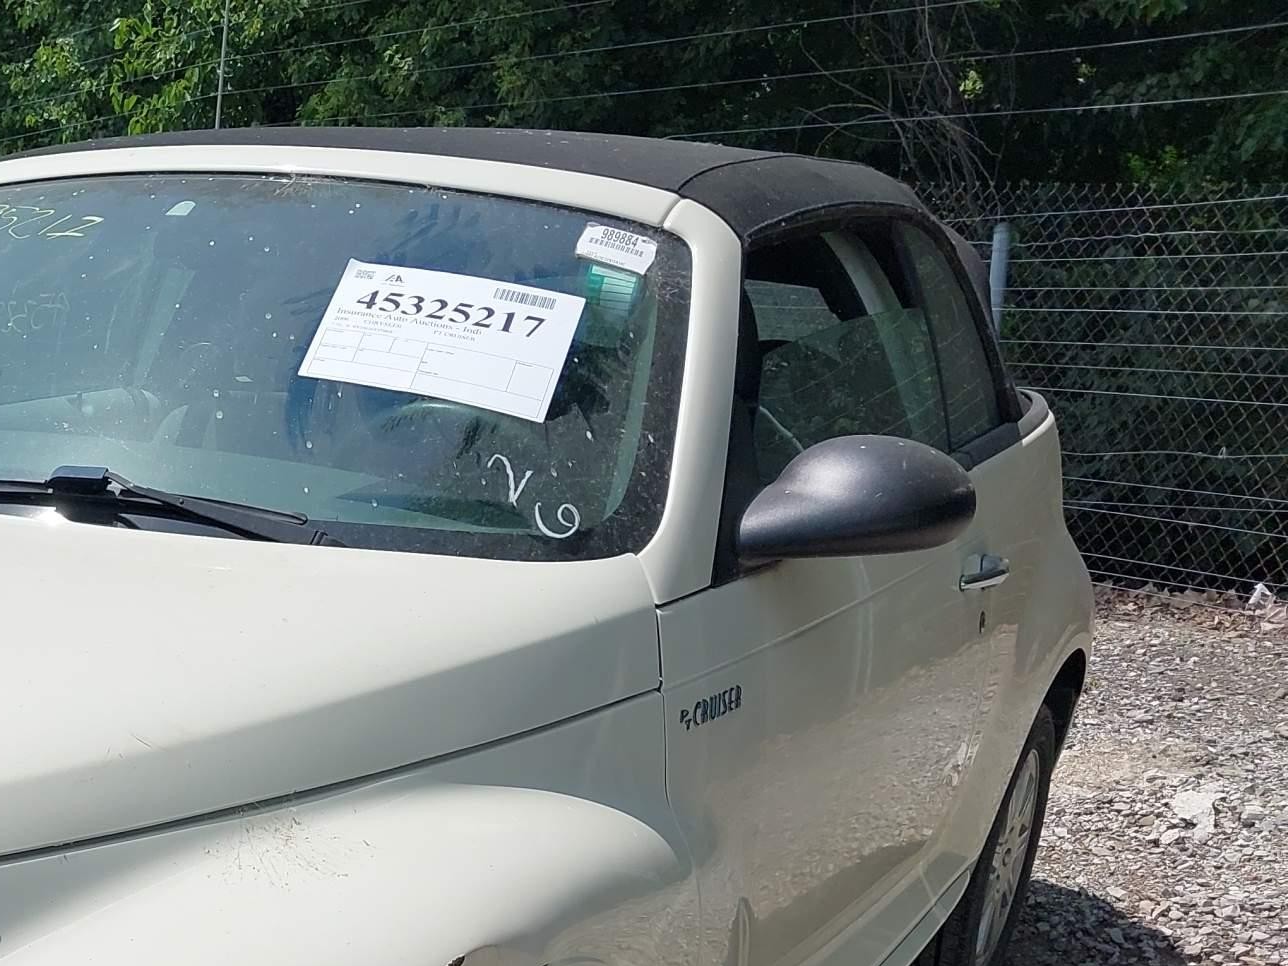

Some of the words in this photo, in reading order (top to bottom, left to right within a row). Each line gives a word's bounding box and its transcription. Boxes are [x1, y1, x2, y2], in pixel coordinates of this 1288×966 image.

[600, 228, 640, 248] 989884
[355, 289, 547, 339] 45325217
[410, 318, 453, 330] Auctions
[693, 684, 742, 727] CRUISER
